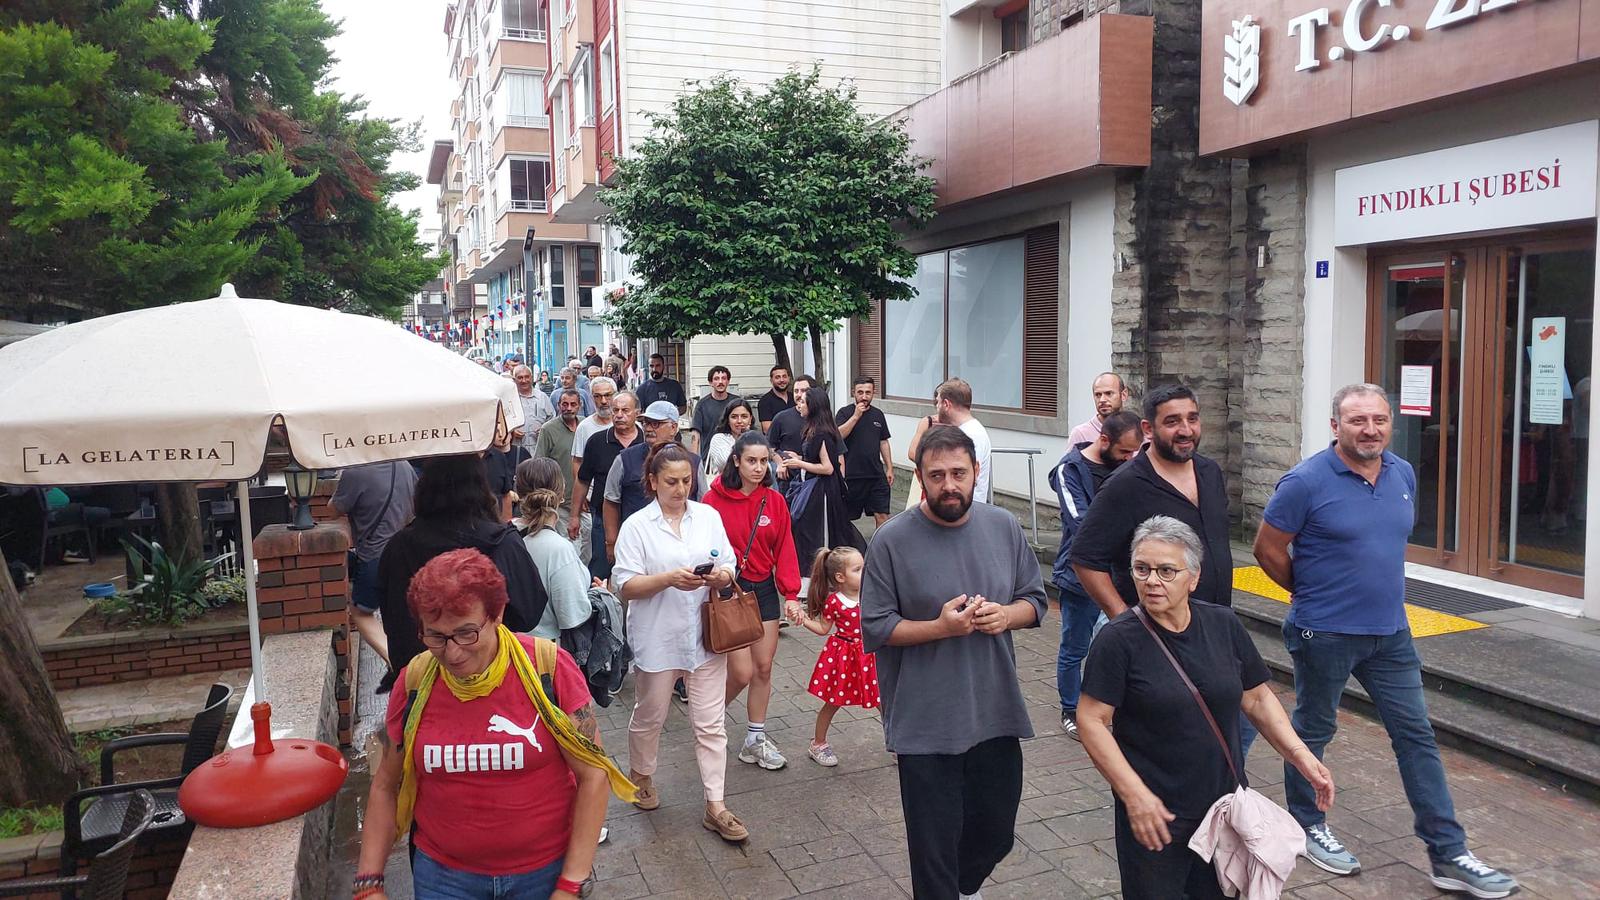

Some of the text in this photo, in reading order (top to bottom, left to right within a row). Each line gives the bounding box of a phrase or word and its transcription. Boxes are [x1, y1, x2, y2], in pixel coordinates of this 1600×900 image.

[1287, 0, 1411, 73] T.C.
[1358, 157, 1562, 217] FINDIKLI ŞUBESİ
[332, 426, 462, 450] LA GELATERIA
[38, 447, 222, 466] LA GELATERIA
[423, 742, 524, 774] PUMA
